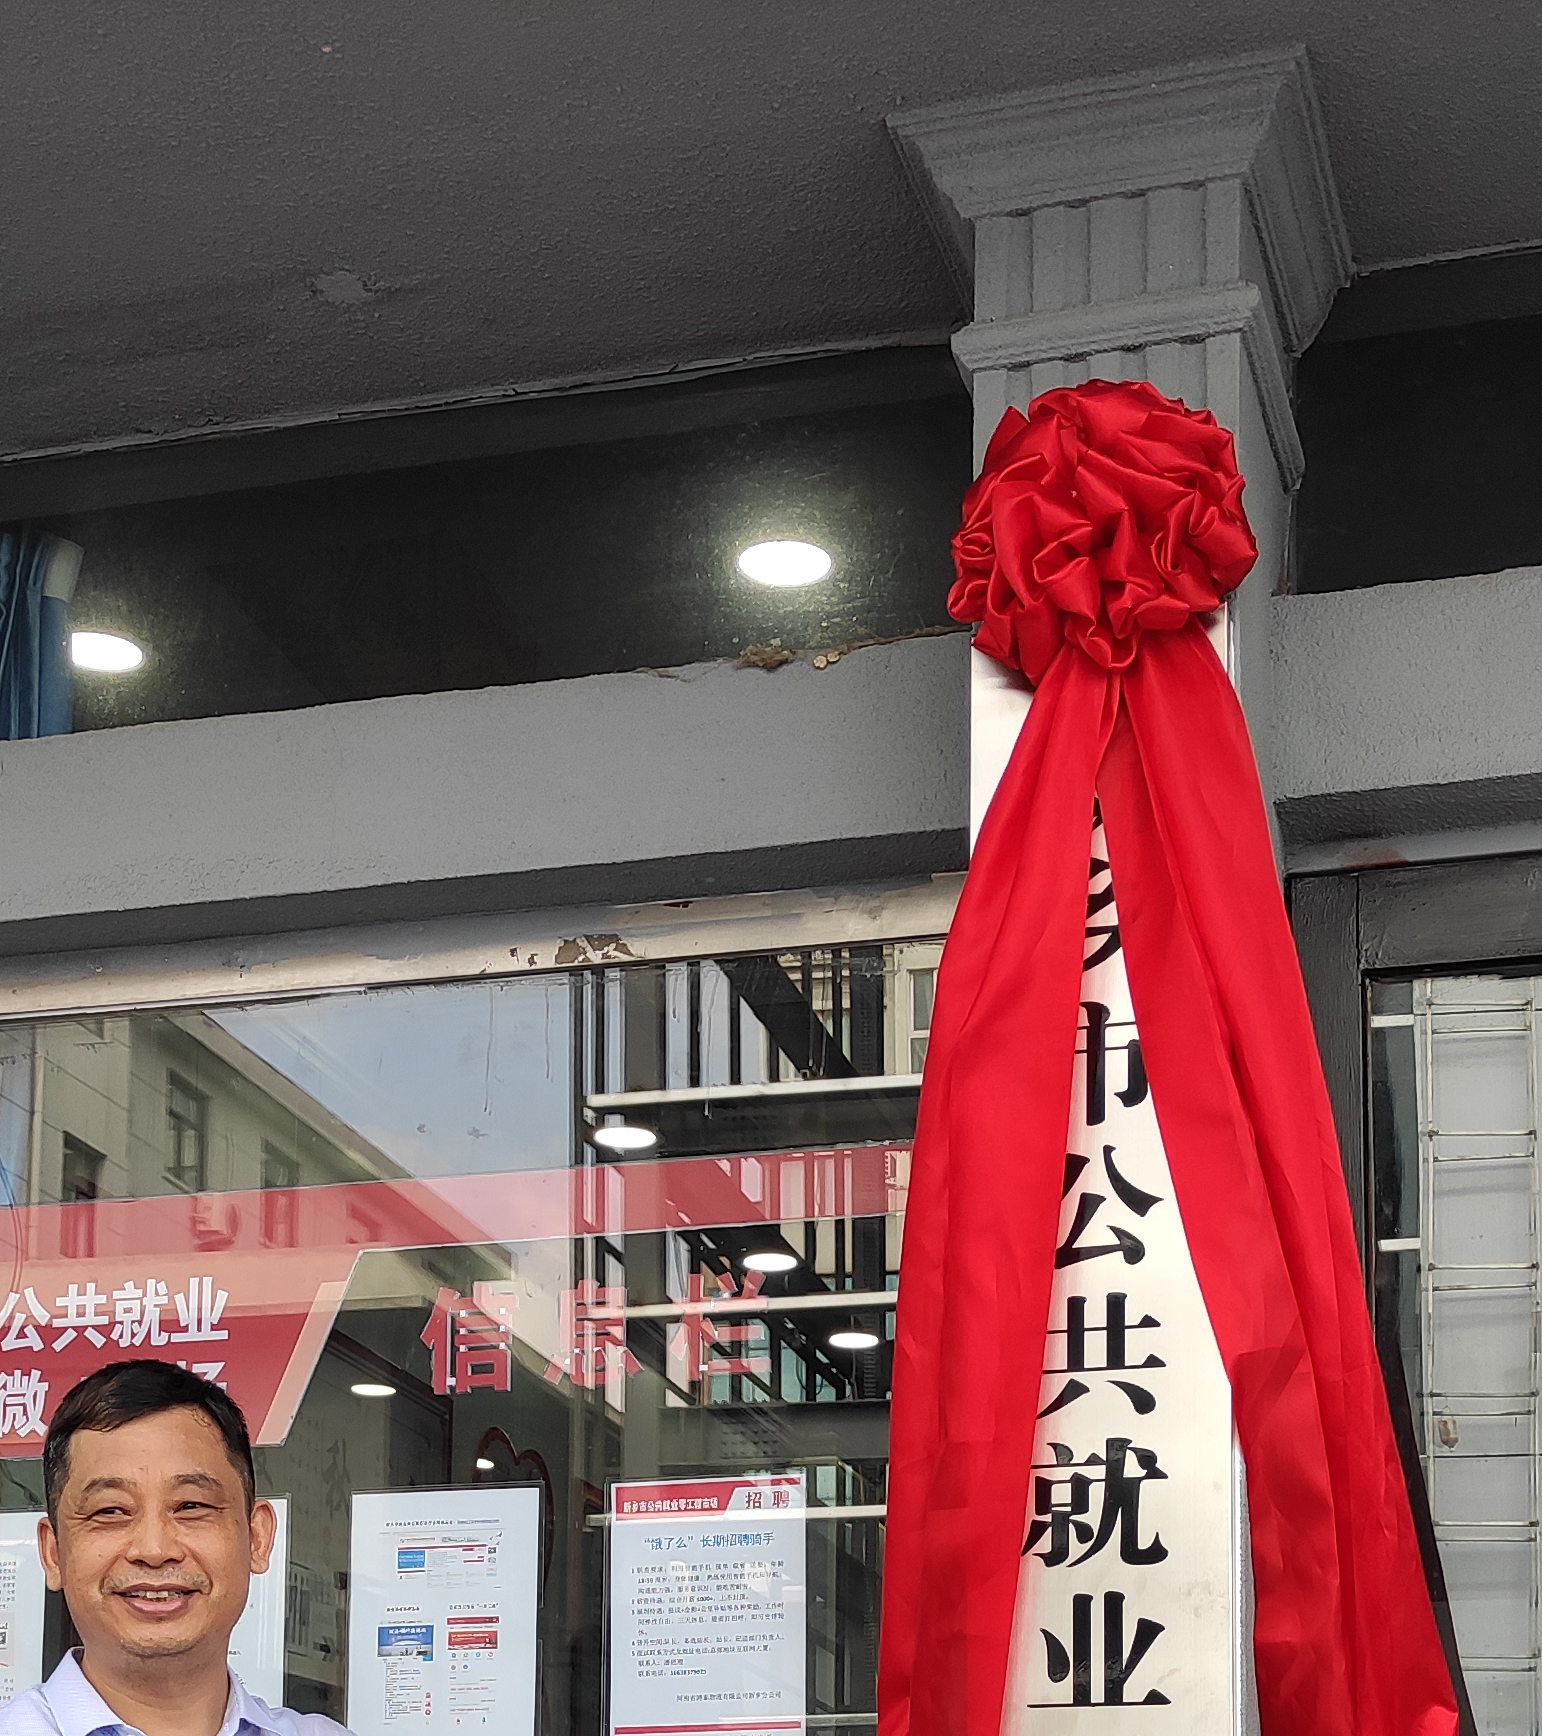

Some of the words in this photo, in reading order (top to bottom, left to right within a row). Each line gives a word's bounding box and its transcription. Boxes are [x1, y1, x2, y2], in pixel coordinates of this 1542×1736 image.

[419, 1271, 771, 1398] 信息栏
[745, 1490, 790, 1509] 招聘
